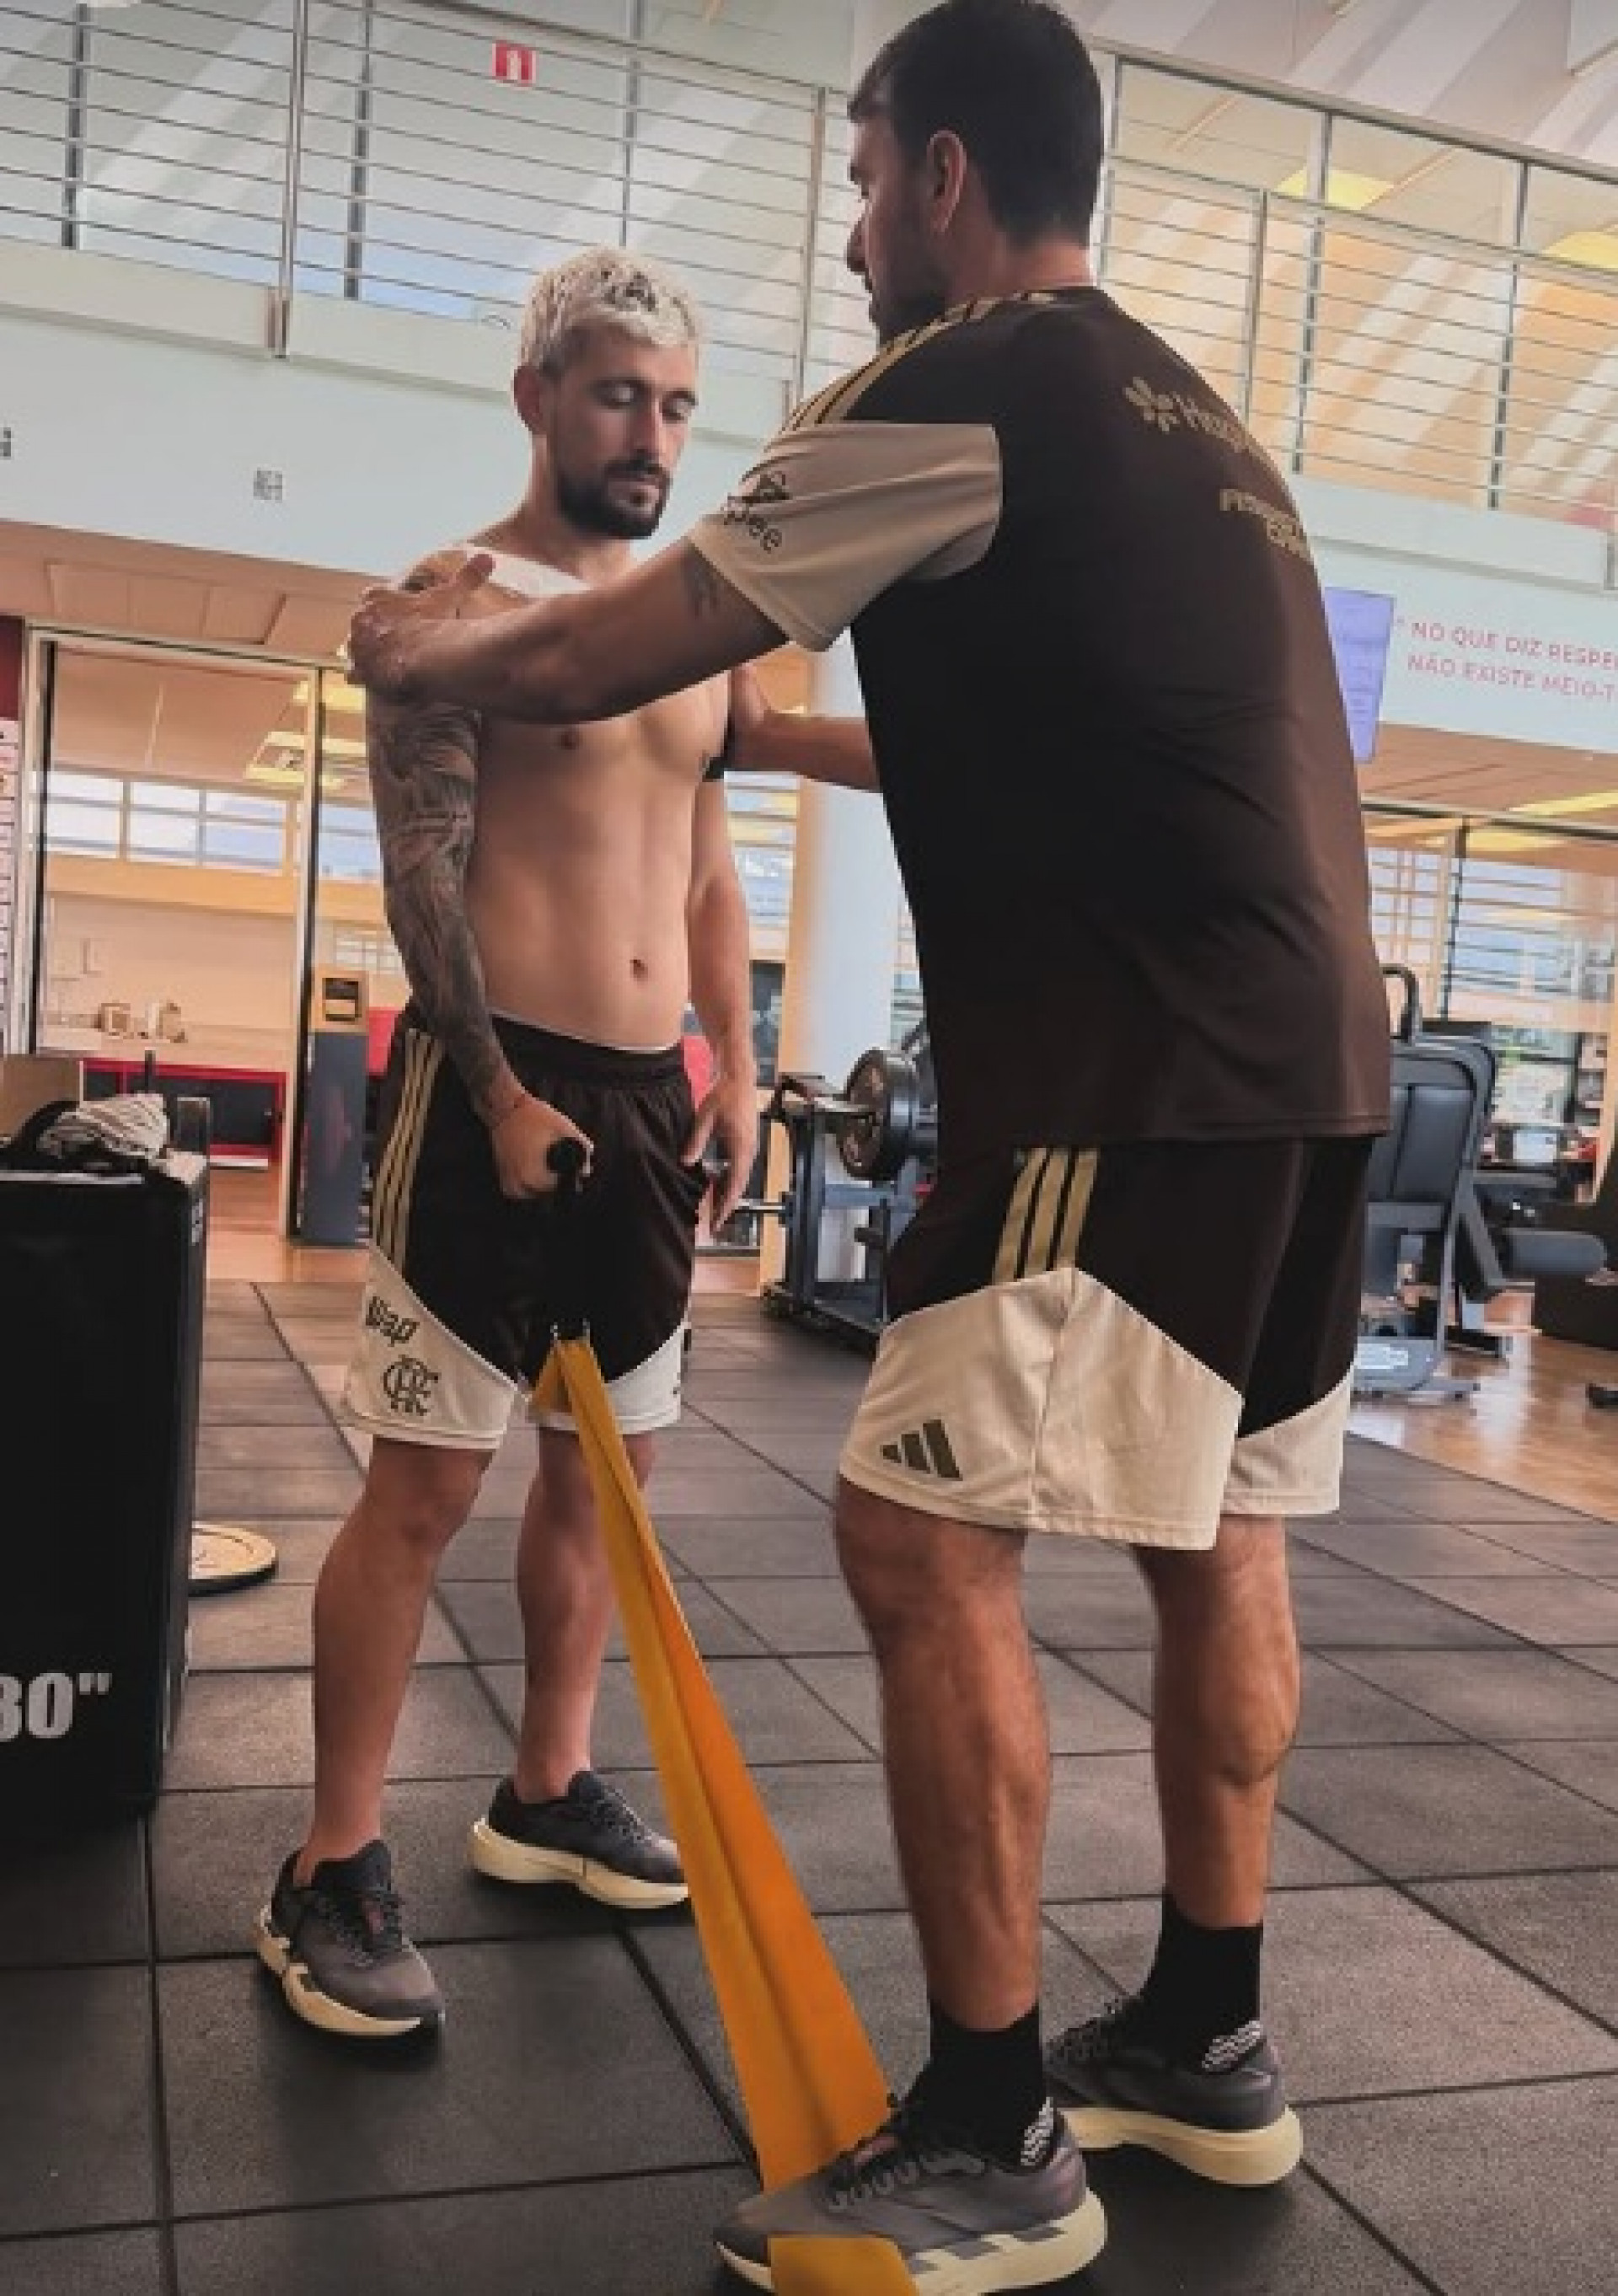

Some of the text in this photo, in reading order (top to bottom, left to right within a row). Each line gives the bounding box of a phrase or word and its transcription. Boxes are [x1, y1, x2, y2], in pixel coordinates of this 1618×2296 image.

[1451, 626, 1498, 648] QUE
[1505, 636, 1542, 658] DIZ
[1465, 662, 1535, 689] EXISTE
